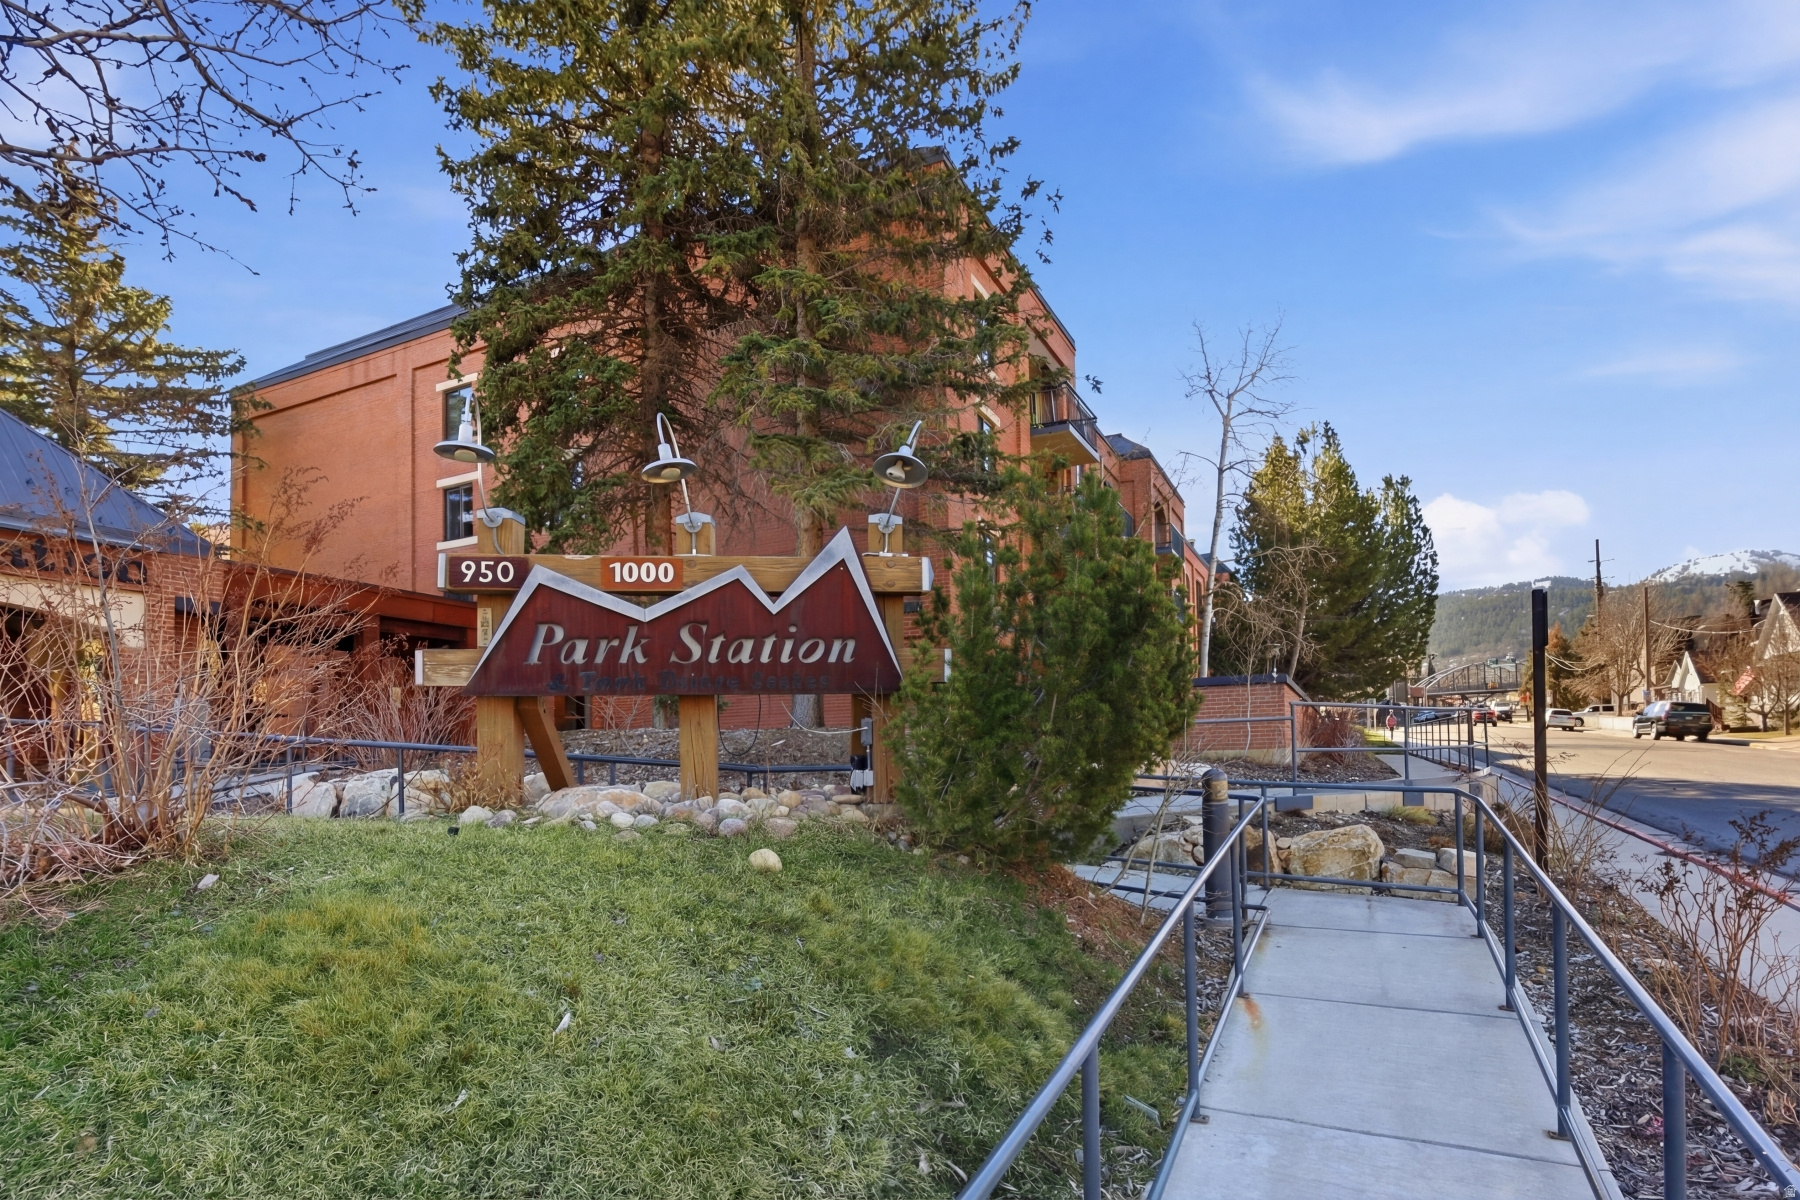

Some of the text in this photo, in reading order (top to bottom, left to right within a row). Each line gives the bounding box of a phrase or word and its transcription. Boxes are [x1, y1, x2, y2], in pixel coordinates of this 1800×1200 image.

[460, 560, 515, 583] 950
[609, 561, 675, 583] 1000
[522, 623, 651, 666] Park
[668, 622, 856, 665] Station
